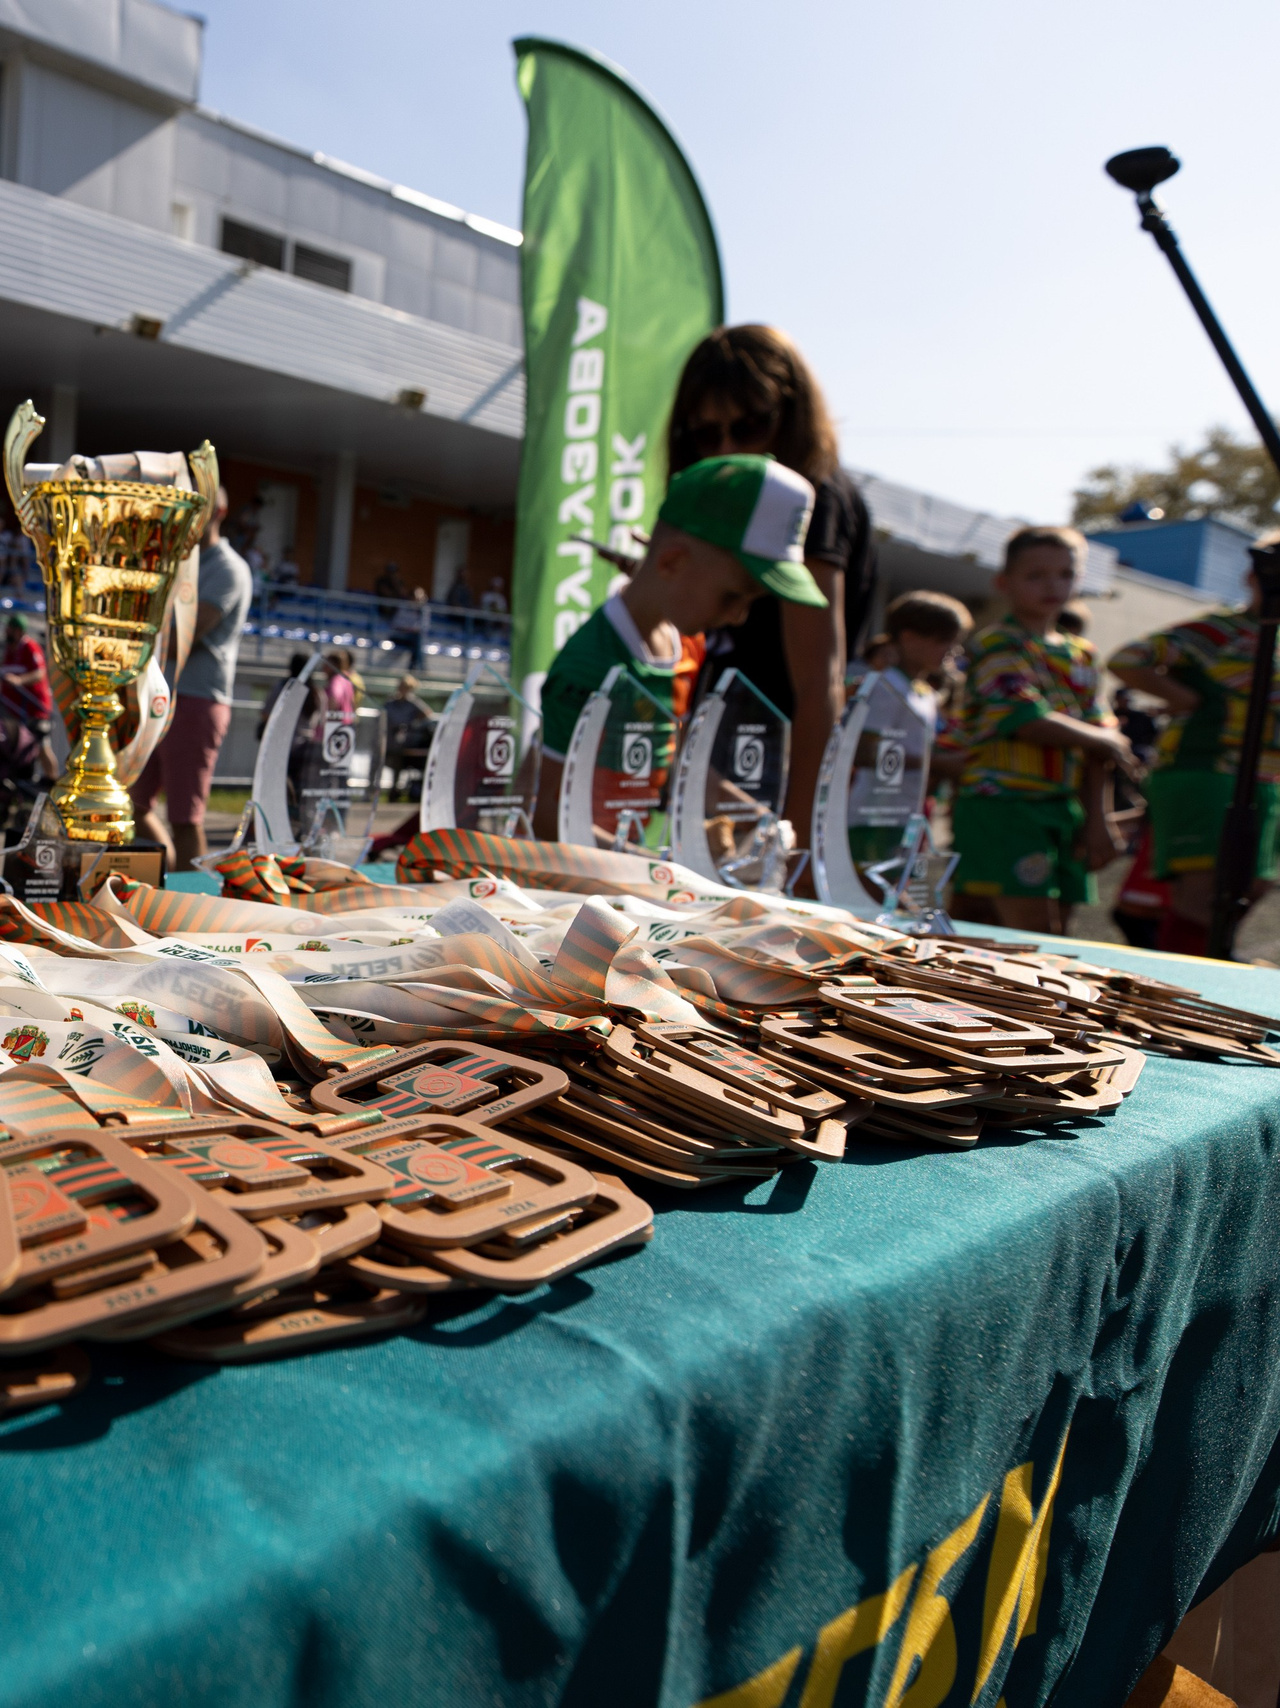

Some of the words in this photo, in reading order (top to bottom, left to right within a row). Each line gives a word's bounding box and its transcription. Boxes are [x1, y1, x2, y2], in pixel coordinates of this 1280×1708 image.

[328, 1065, 378, 1086] ПЕРВЕНСТВО
[377, 1046, 430, 1070] ЗЕЛЕНОГРАДА
[383, 1063, 433, 1086] КУБОК
[443, 1084, 493, 1107] БУТУЗОВА
[483, 1099, 516, 1115] 2024
[362, 1118, 422, 1141] ЗЕЛЕНОГРАДА
[371, 1142, 428, 1161] КУБОК
[499, 1200, 538, 1217] 2024
